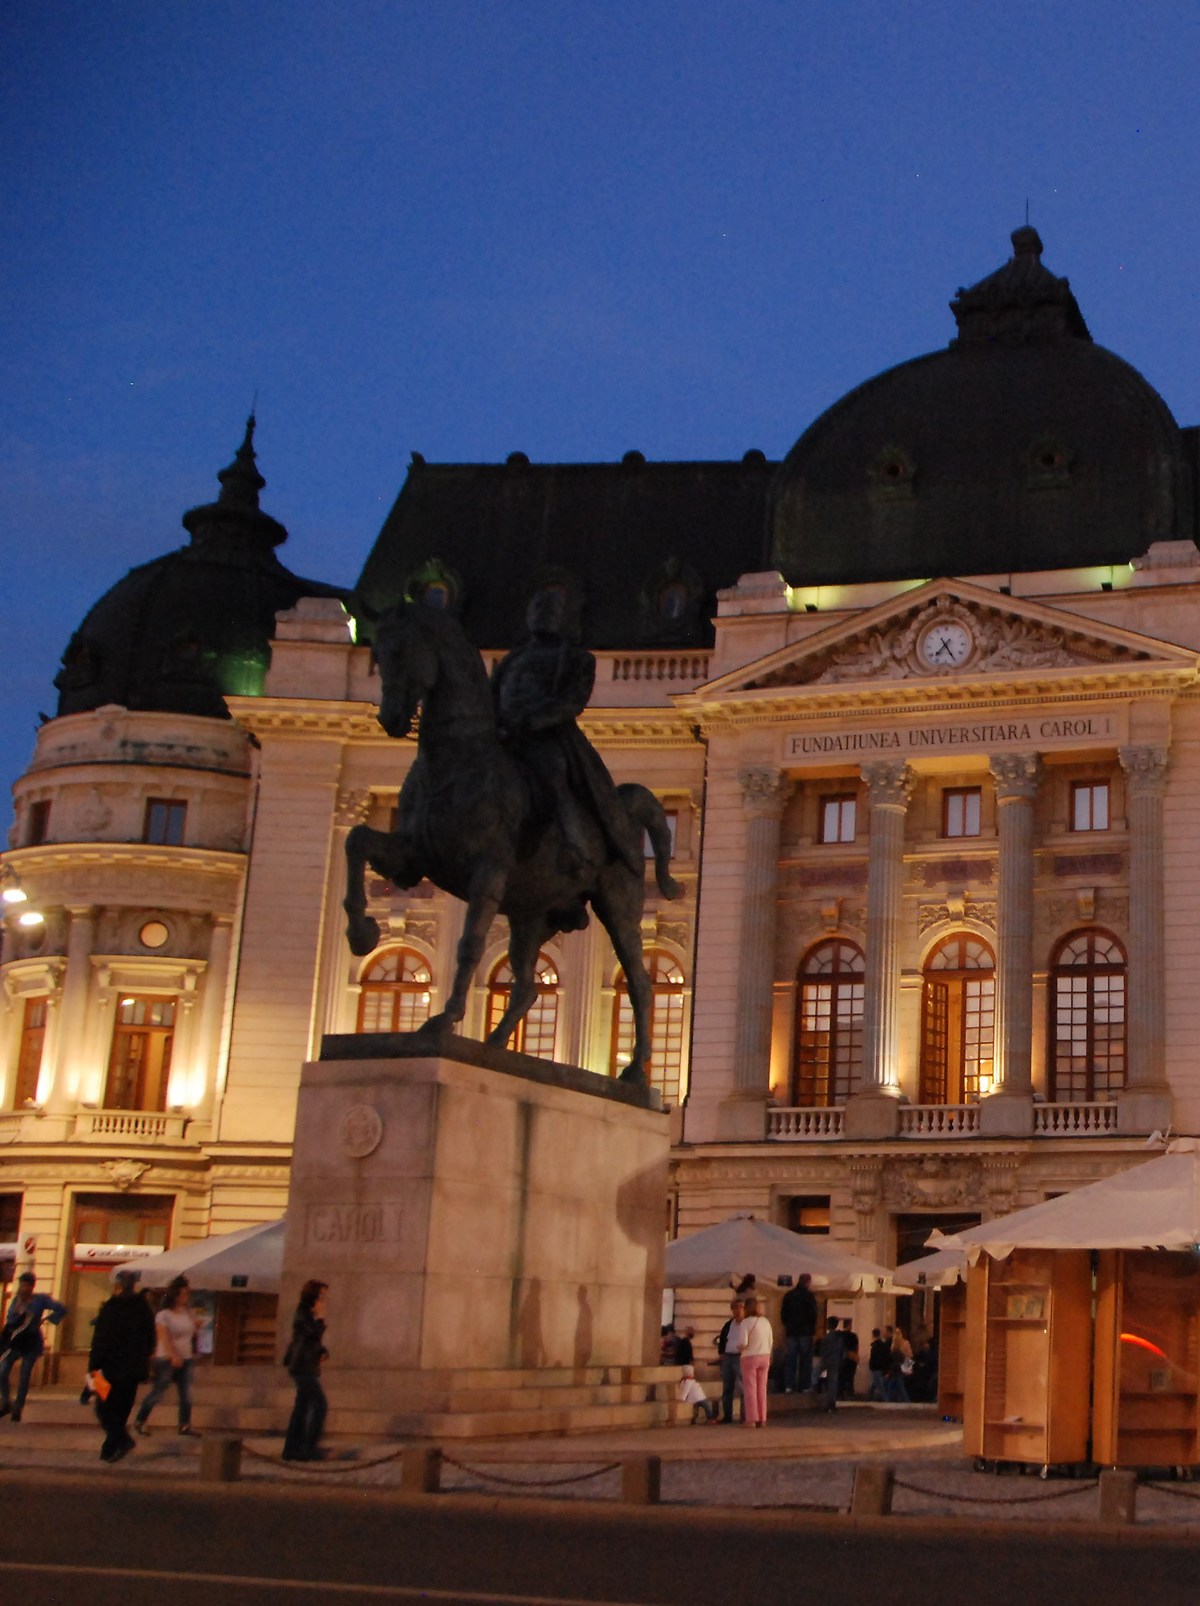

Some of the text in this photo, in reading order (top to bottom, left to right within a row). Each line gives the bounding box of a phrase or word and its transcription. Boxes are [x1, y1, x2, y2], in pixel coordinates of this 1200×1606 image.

[909, 723, 1031, 745] UNIVERSITARA
[1040, 719, 1097, 737] CAROL
[1105, 718, 1111, 733] I
